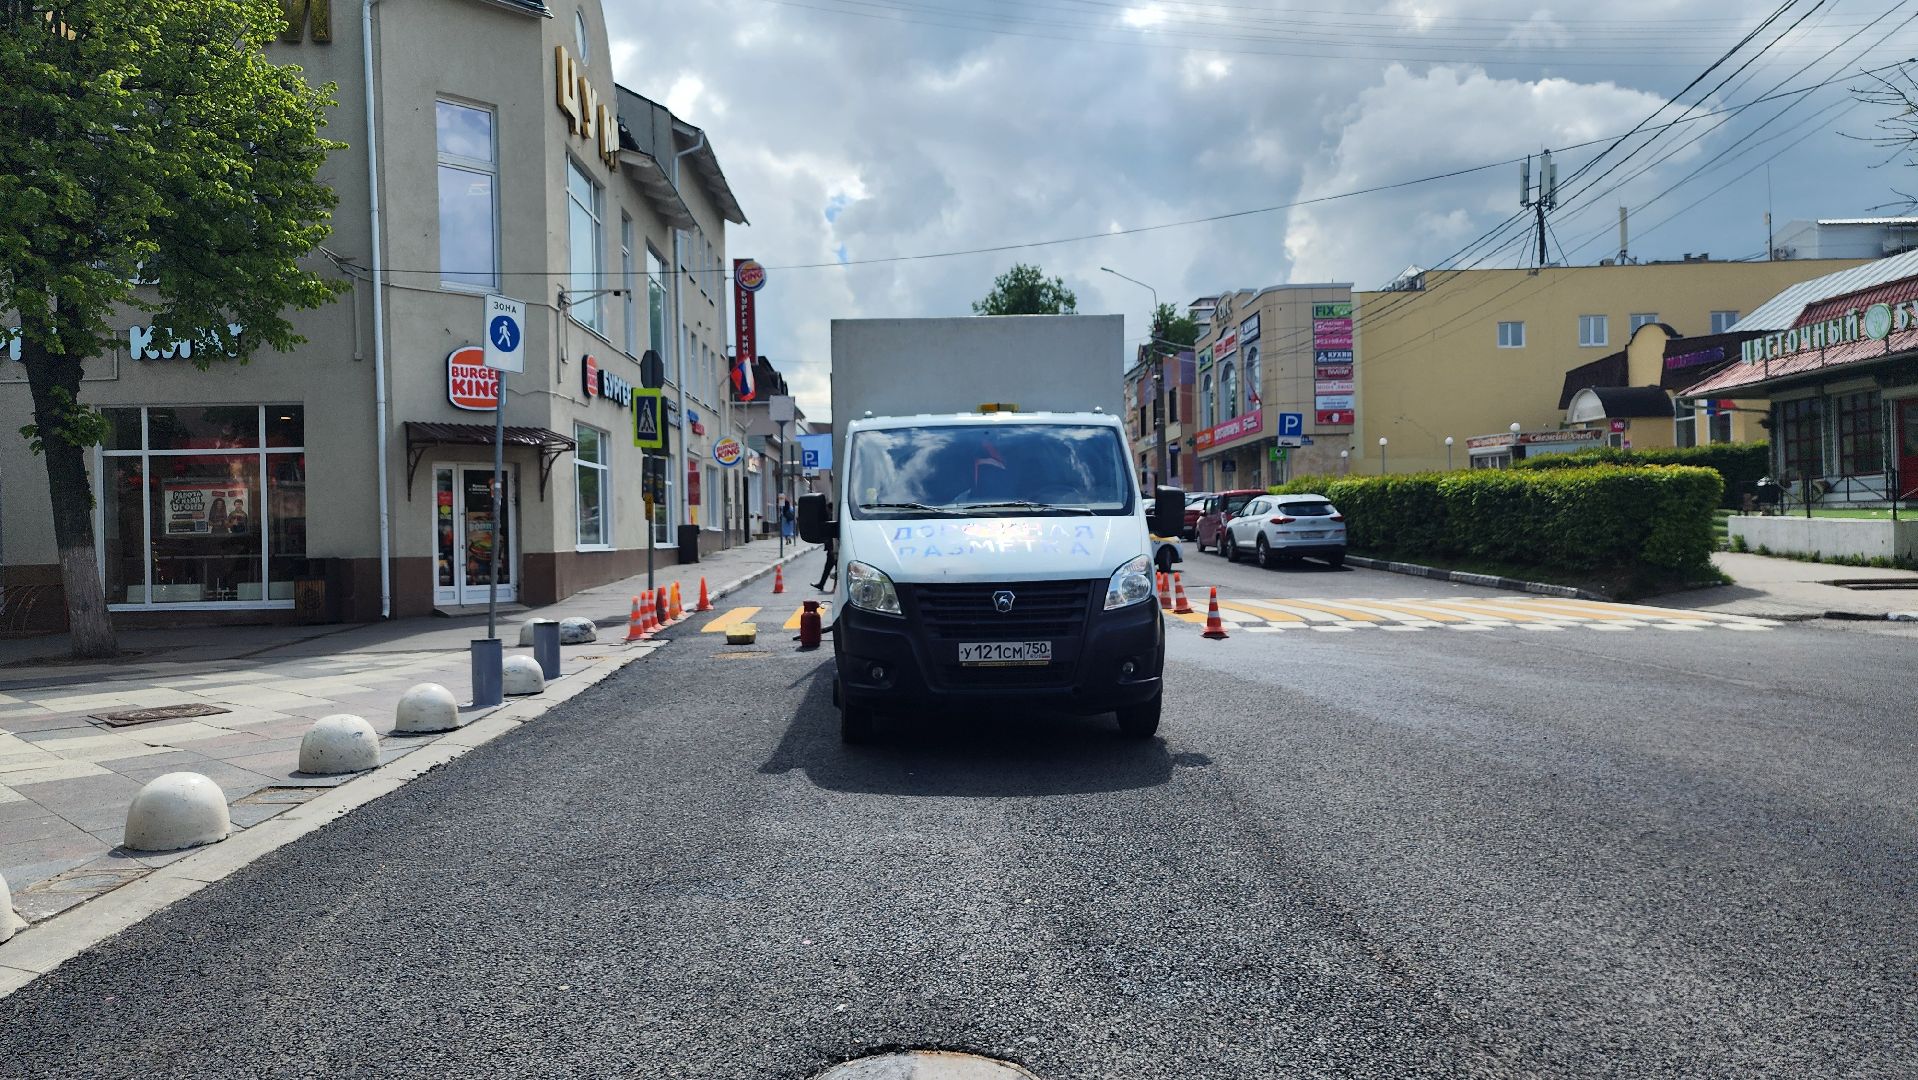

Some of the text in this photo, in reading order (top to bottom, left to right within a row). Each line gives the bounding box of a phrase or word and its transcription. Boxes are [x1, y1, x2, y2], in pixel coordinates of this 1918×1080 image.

[555, 46, 620, 171] ЦУМ
[494, 302, 517, 313] ЗОНА
[1741, 307, 1860, 365] ЦВЕТОЧНЫЙ
[718, 447, 740, 459] KING
[1025, 643, 1047, 655] 750
